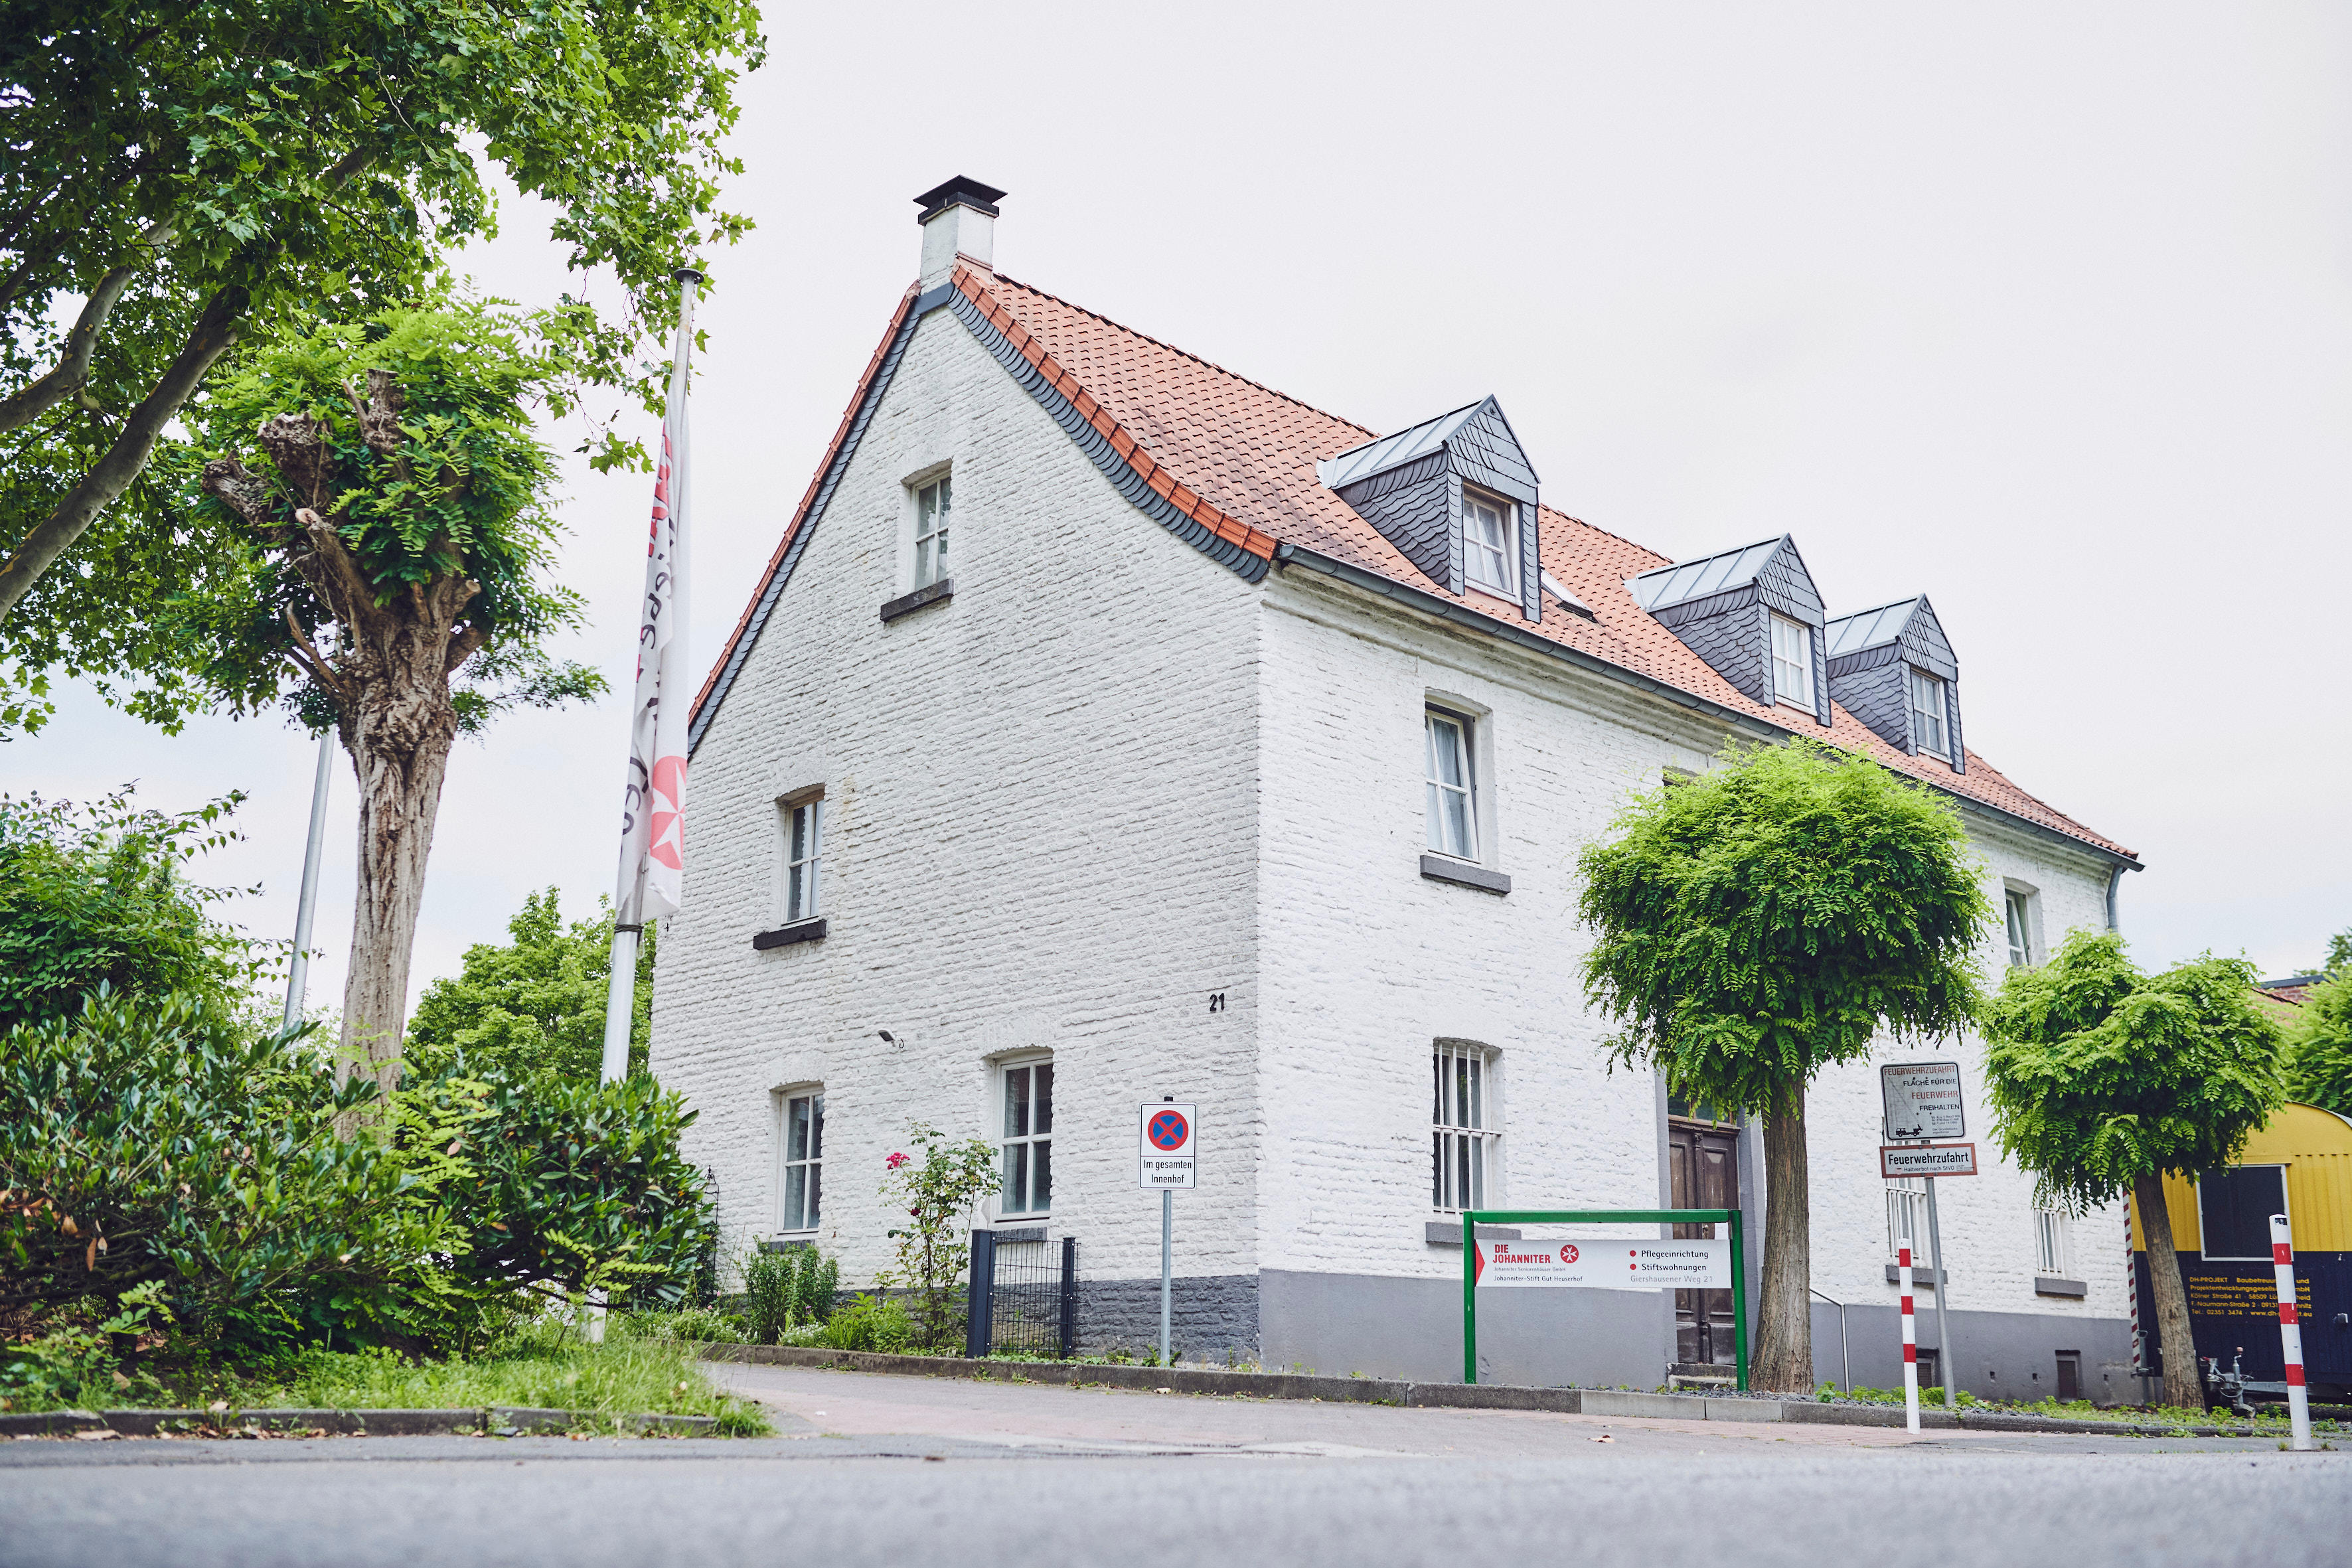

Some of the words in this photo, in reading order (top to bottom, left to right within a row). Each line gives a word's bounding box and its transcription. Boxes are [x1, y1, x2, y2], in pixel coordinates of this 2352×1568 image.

[1210, 992, 1225, 1012] 21
[1884, 1065, 1955, 1075] FEUERWEHRZUFAHRT
[1912, 1091, 1958, 1099] FEUERWEHR
[1888, 1152, 1969, 1165] Feuerwehrzufahrt
[1144, 1160, 1153, 1168] Im
[1156, 1160, 1192, 1170] gesamten
[1151, 1174, 1184, 1184] Innenhof
[1494, 1244, 1509, 1253] DIE
[1492, 1254, 1551, 1263] JOHANNITER
[1641, 1250, 1709, 1259] Pflegeeinrichtung
[1642, 1263, 1707, 1272] Stiftswohnungen
[1684, 1275, 1701, 1284] Weg
